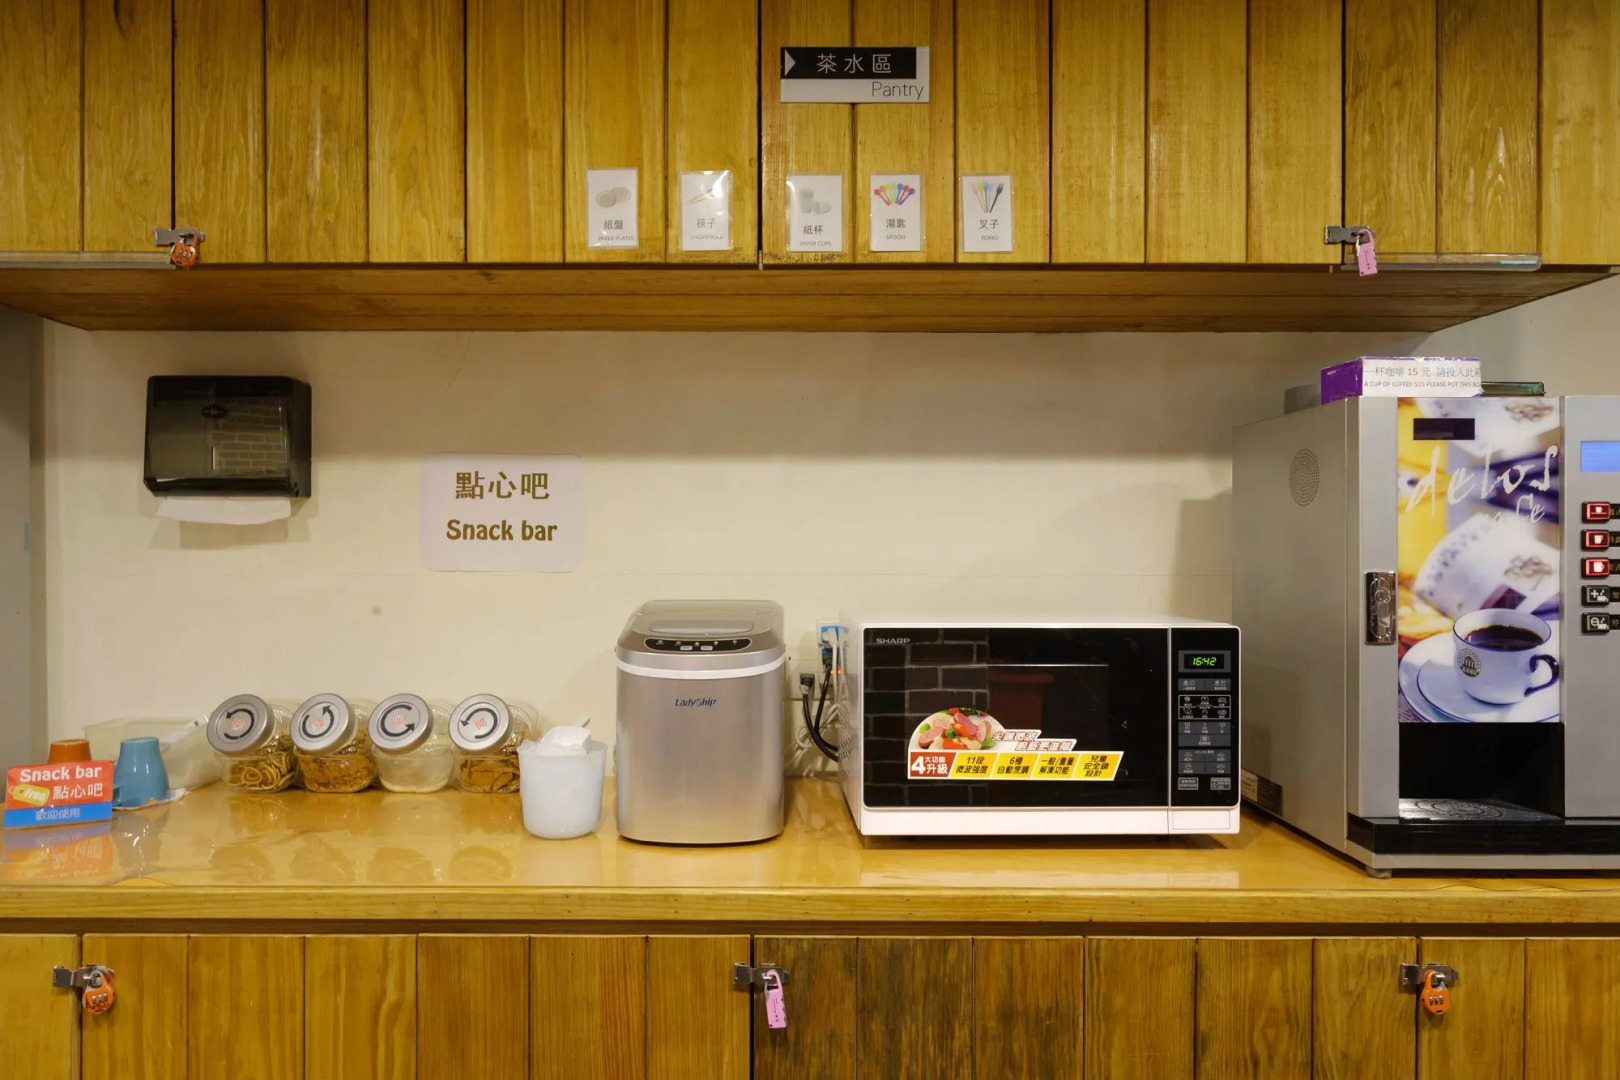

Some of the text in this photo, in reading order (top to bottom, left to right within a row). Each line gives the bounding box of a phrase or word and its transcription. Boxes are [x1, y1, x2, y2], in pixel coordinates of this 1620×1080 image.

[817, 53, 892, 74] 茶水區
[872, 81, 924, 100] Pantry
[696, 217, 716, 229] 筷子
[886, 218, 906, 229] 湯匙
[979, 219, 999, 229] 叉子
[803, 224, 823, 235] 紙杯
[1364, 366, 1404, 378] 一杯咖啡
[1408, 366, 1418, 376] 15
[1422, 366, 1431, 377] 元
[455, 470, 550, 500] 點心吧
[446, 519, 558, 541] Snack bar
[875, 637, 911, 645] SHARP
[1193, 656, 1217, 666] 16:42
[675, 697, 717, 708] LadyShip
[911, 755, 926, 775] 4
[966, 756, 984, 765] 11段
[1009, 756, 1023, 765] 6種
[20, 765, 103, 782] Snack bar
[925, 763, 949, 775] 升級
[53, 783, 103, 800] 點心吧
